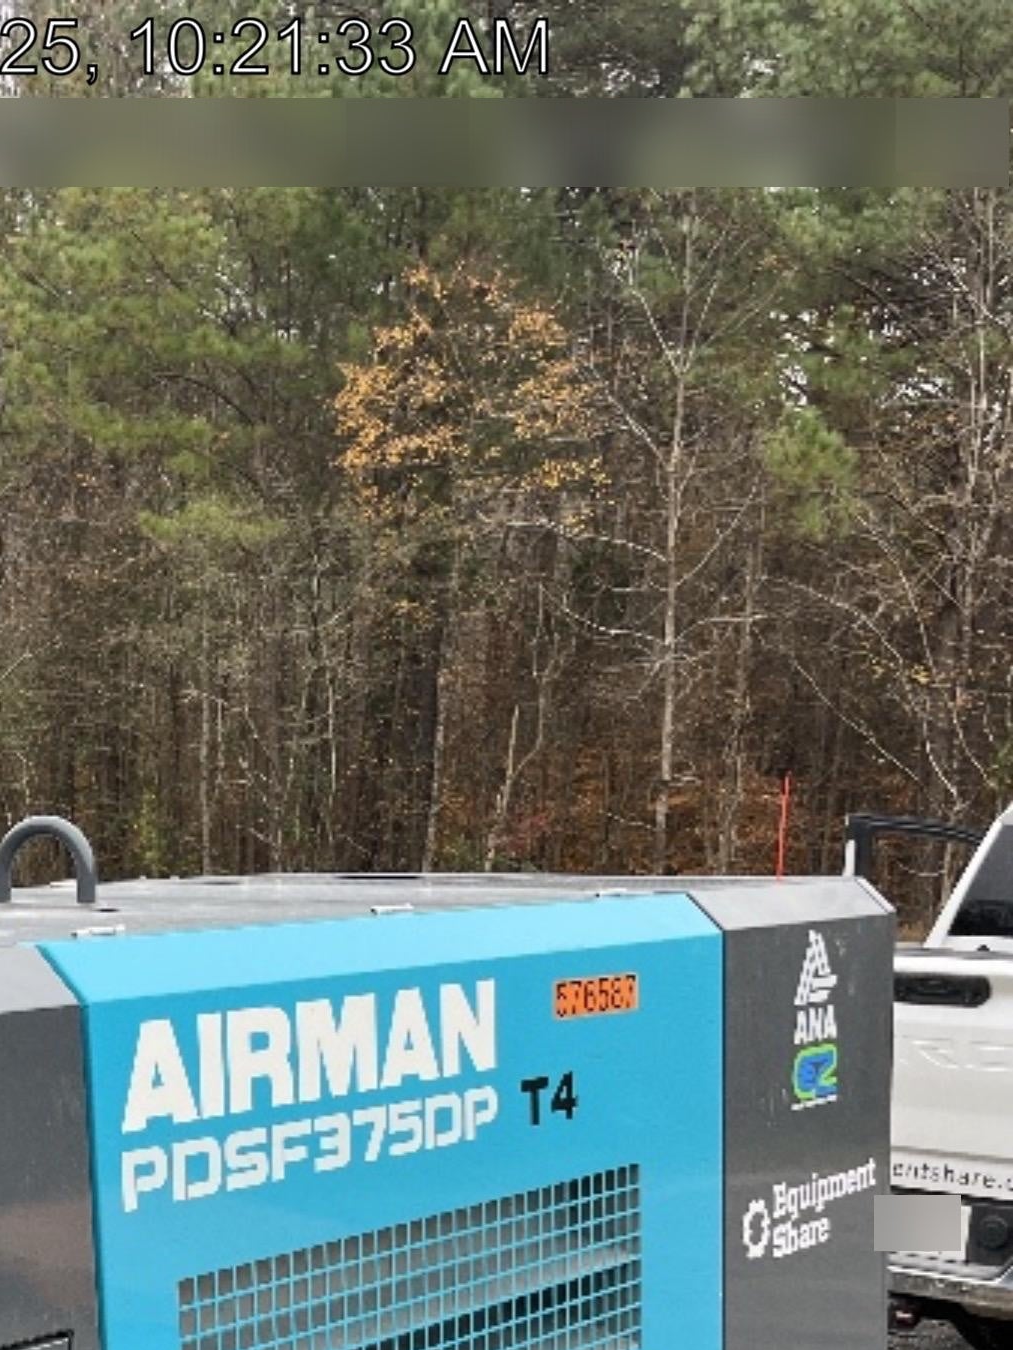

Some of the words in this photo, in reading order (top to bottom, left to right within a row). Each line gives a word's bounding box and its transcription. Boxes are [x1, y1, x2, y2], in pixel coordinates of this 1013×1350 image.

[555, 974, 636, 1018] 576587
[794, 1004, 838, 1045] ANA
[121, 978, 498, 1135] AIRMAN
[520, 1071, 579, 1126] T4
[121, 1085, 499, 1213] PDSF375DP
[772, 1157, 876, 1221] Equipment
[772, 1216, 831, 1259] Share
